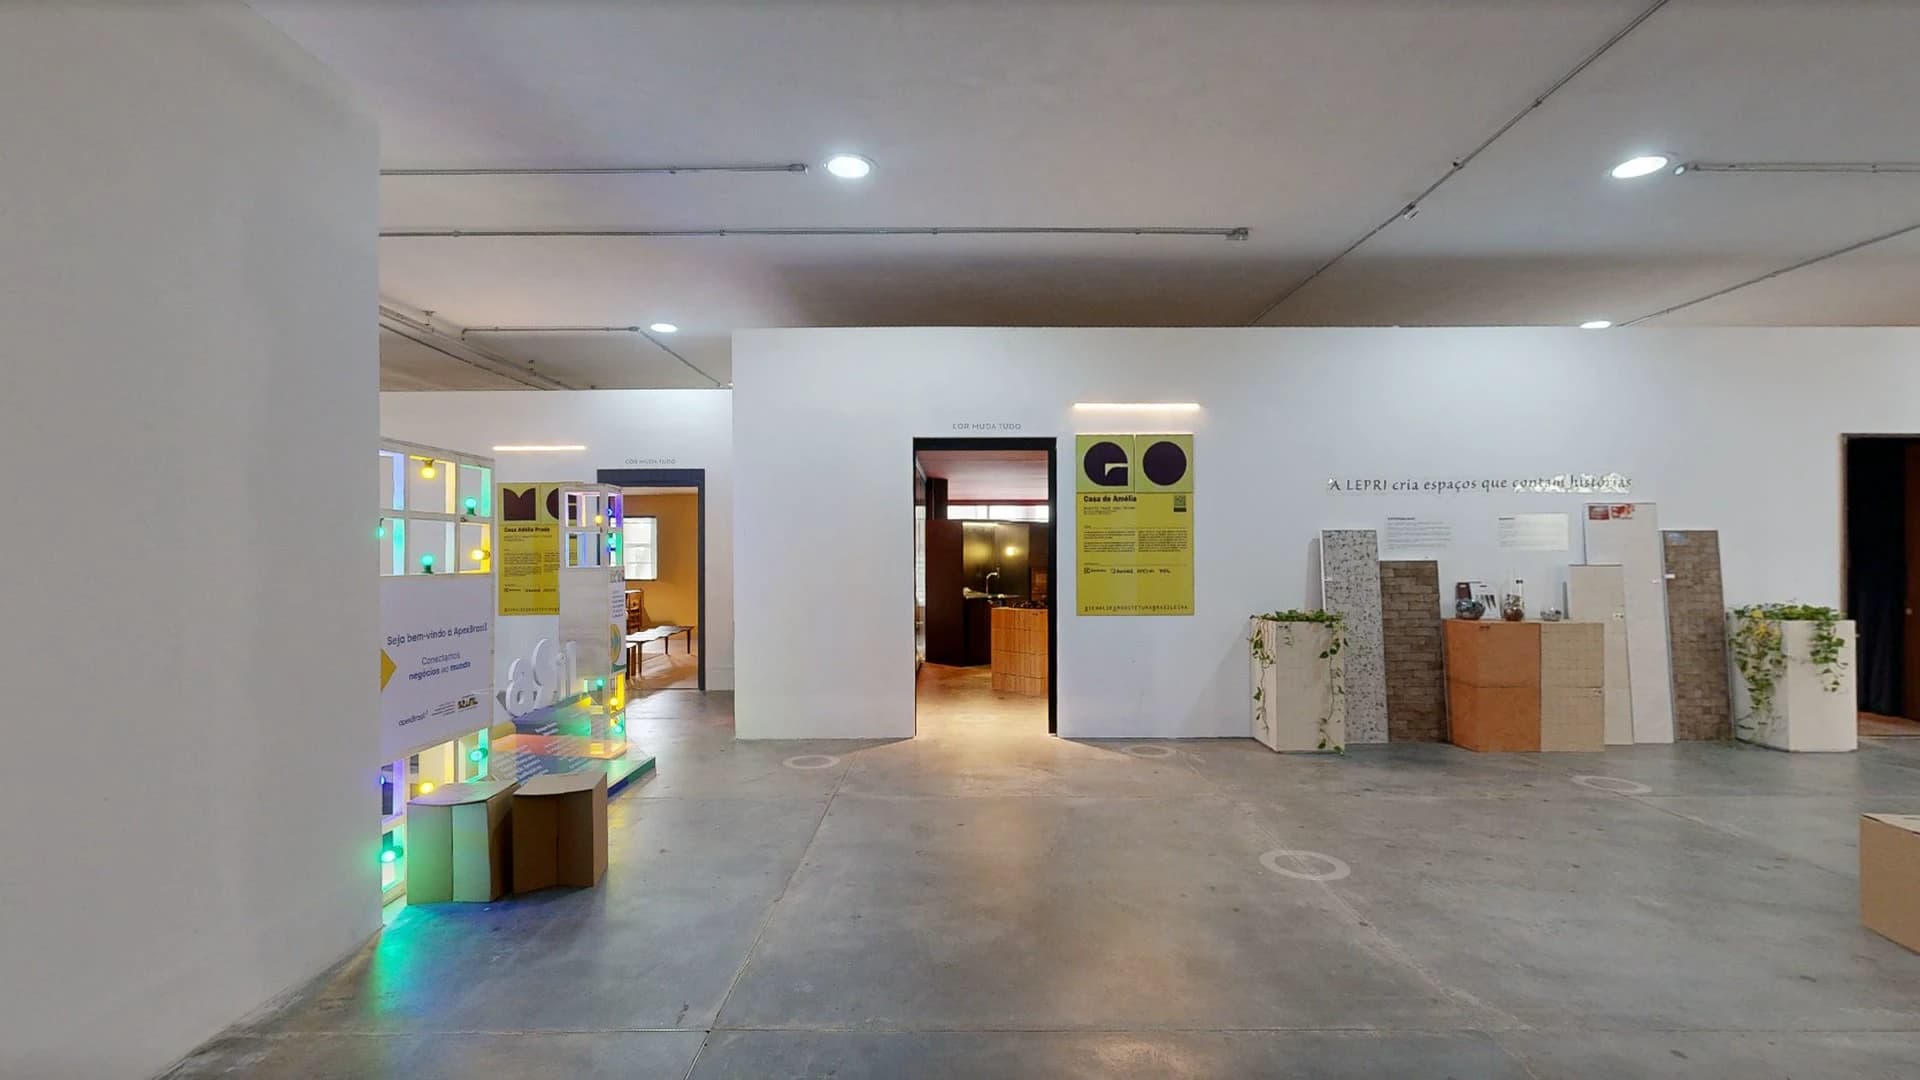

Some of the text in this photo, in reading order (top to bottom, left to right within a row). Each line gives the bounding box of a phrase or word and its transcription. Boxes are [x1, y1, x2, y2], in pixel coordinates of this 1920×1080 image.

[1330, 479, 1341, 491] A
[1346, 479, 1387, 491] LEPRI
[1392, 478, 1419, 491] cria
[1423, 479, 1477, 494] espaços
[1481, 478, 1507, 493] que
[1113, 494, 1137, 502] Amélia
[387, 636, 405, 647] Seja
[407, 629, 446, 642] bem-vindo
[421, 652, 460, 665] Conectamos
[408, 667, 440, 681] negócios
[450, 660, 471, 671] mundo
